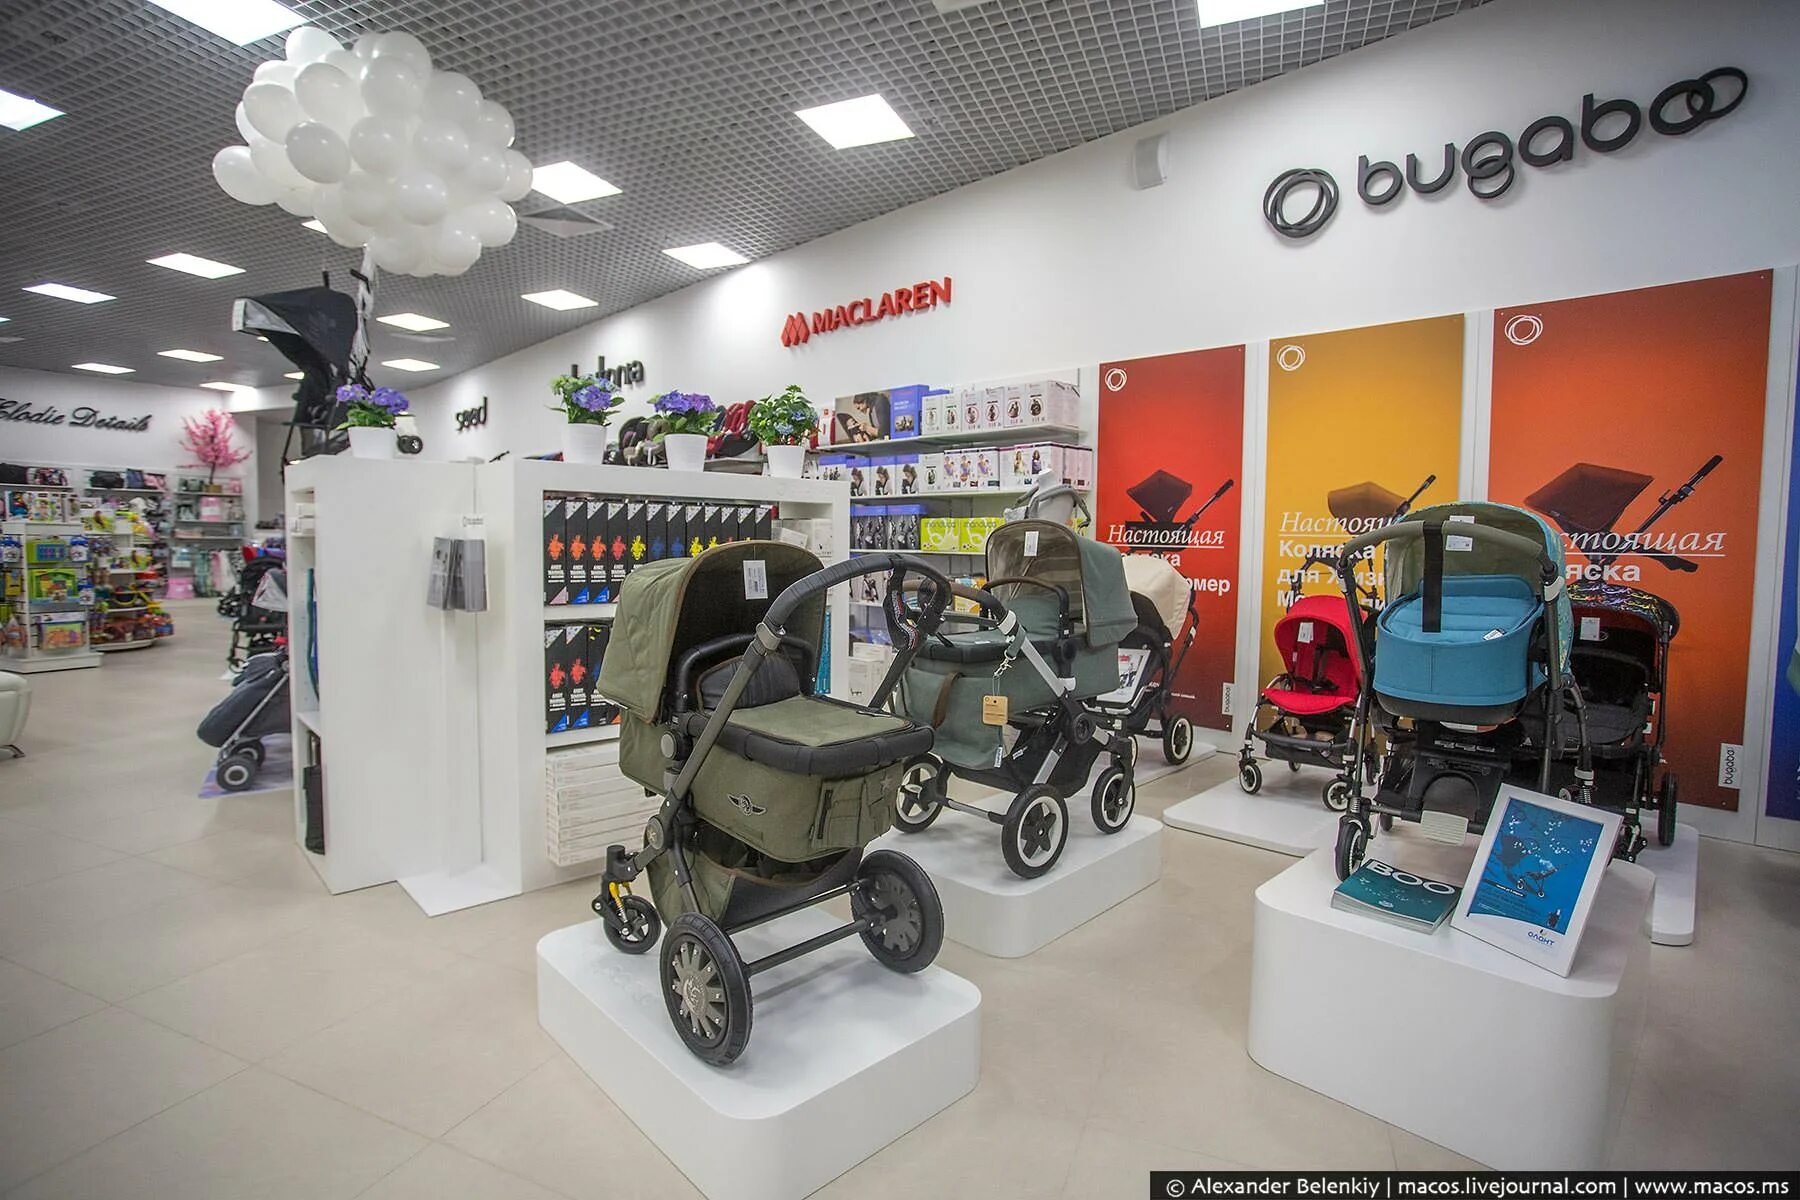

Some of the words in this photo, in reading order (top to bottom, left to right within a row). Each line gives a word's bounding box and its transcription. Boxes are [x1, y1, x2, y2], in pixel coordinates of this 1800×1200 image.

[1357, 66, 1749, 206] bugaboo
[812, 277, 952, 334] MACLAREN
[69, 407, 152, 431] Details
[1107, 524, 1225, 547] Настоящая
